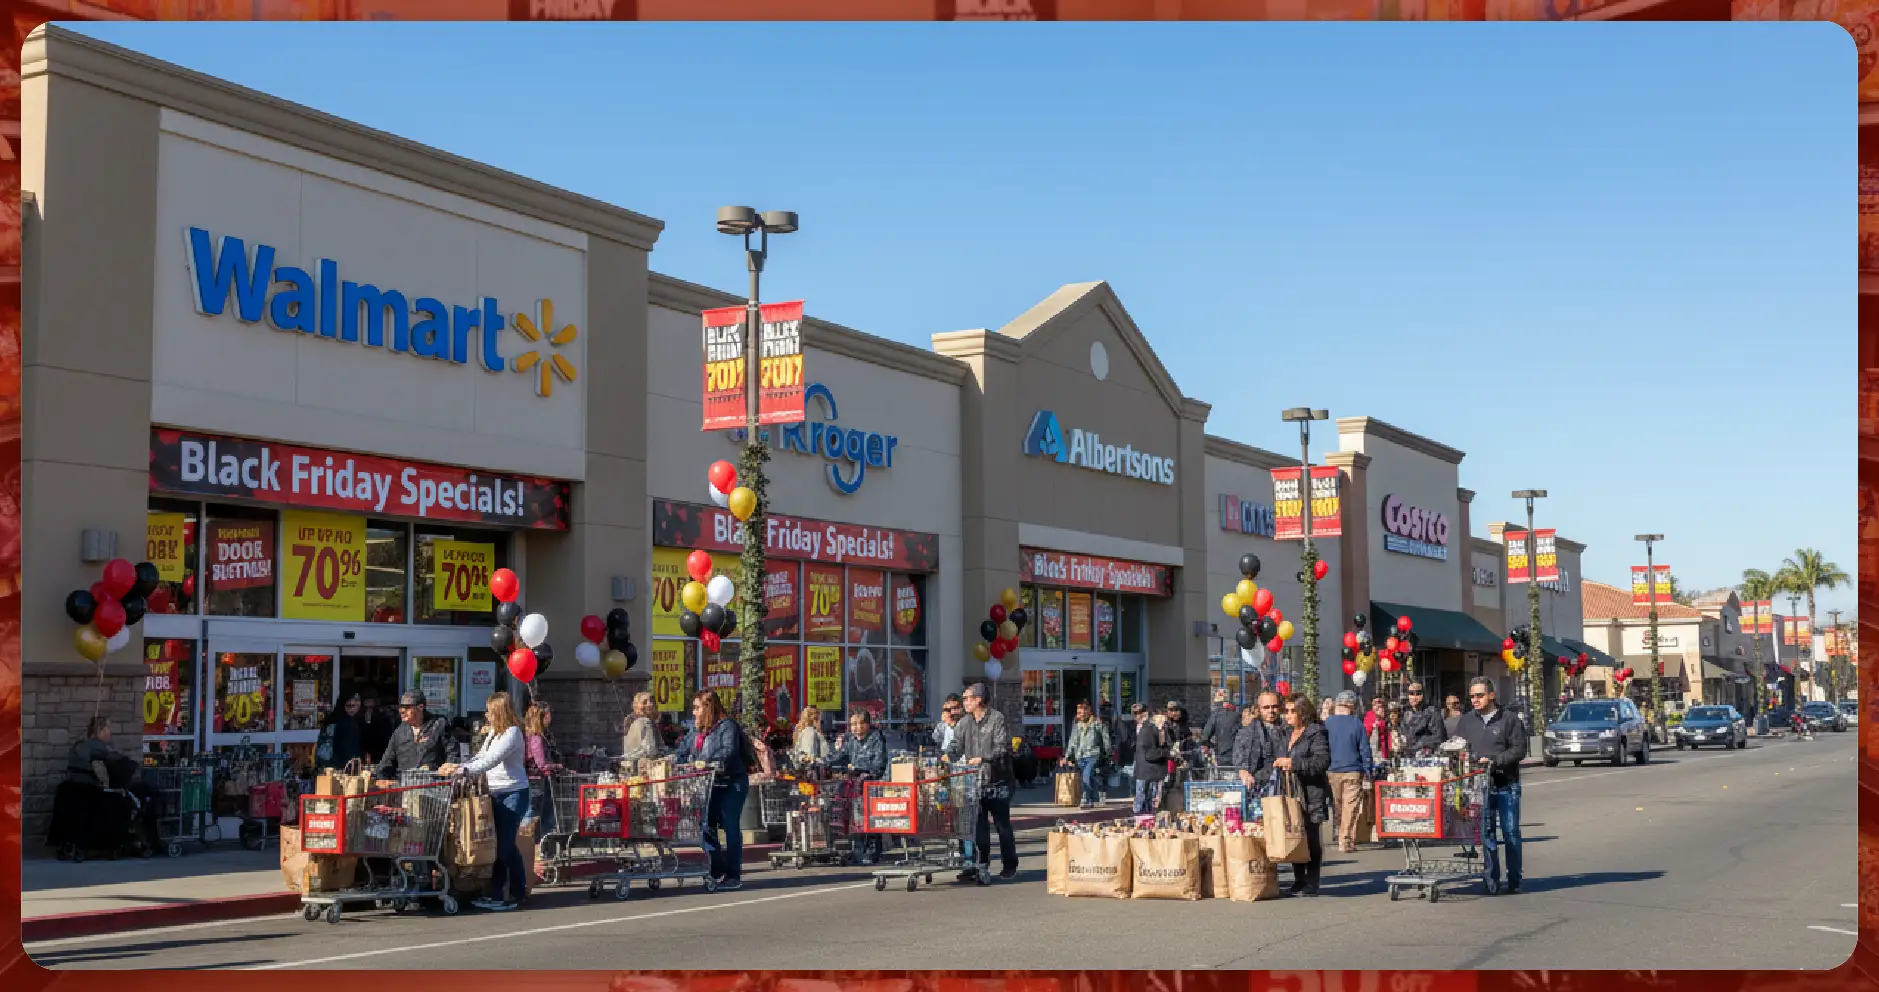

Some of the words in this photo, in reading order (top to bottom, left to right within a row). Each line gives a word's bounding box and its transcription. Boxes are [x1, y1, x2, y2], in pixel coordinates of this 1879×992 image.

[184, 226, 505, 374] Walmart
[180, 440, 281, 491] Black
[291, 453, 393, 513] Friday
[400, 467, 525, 517] Specials!
[1069, 428, 1175, 485] Albertsons
[714, 513, 747, 545] Bla
[766, 518, 821, 560] Friday
